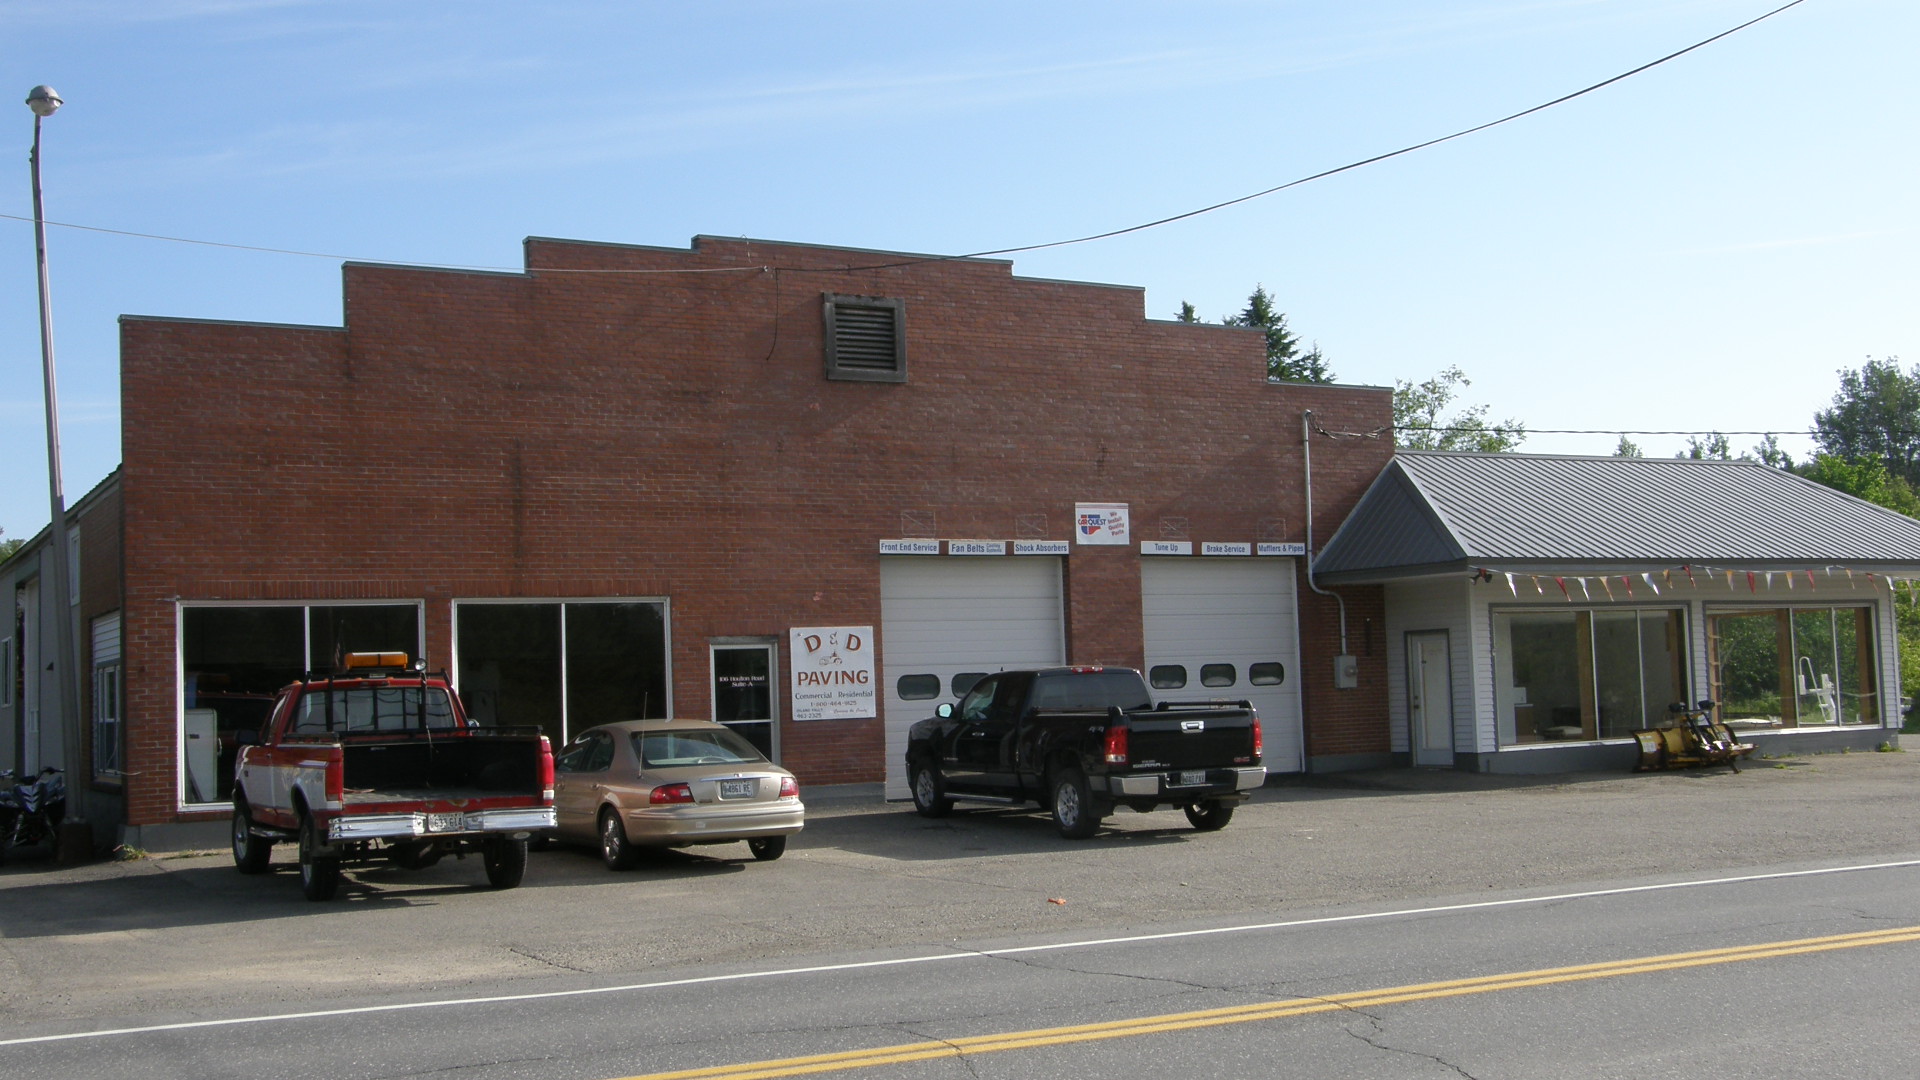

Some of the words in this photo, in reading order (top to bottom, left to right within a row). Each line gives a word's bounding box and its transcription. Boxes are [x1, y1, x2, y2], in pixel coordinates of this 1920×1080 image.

[881, 543, 898, 551] Front
[899, 543, 912, 551] End
[913, 543, 937, 552] Service
[952, 544, 965, 552] Fan
[967, 544, 985, 553] Belts
[1015, 544, 1034, 552] Shock
[1036, 544, 1067, 552] Absorbers
[1154, 543, 1168, 551] Tune
[1170, 543, 1178, 552] Up
[1224, 545, 1245, 553] Service
[1288, 544, 1303, 553] Pipes
[804, 635, 821, 653] D
[830, 632, 838, 645] &
[846, 634, 862, 651] D
[798, 670, 869, 686] PAVING
[795, 692, 832, 700] Commercial
